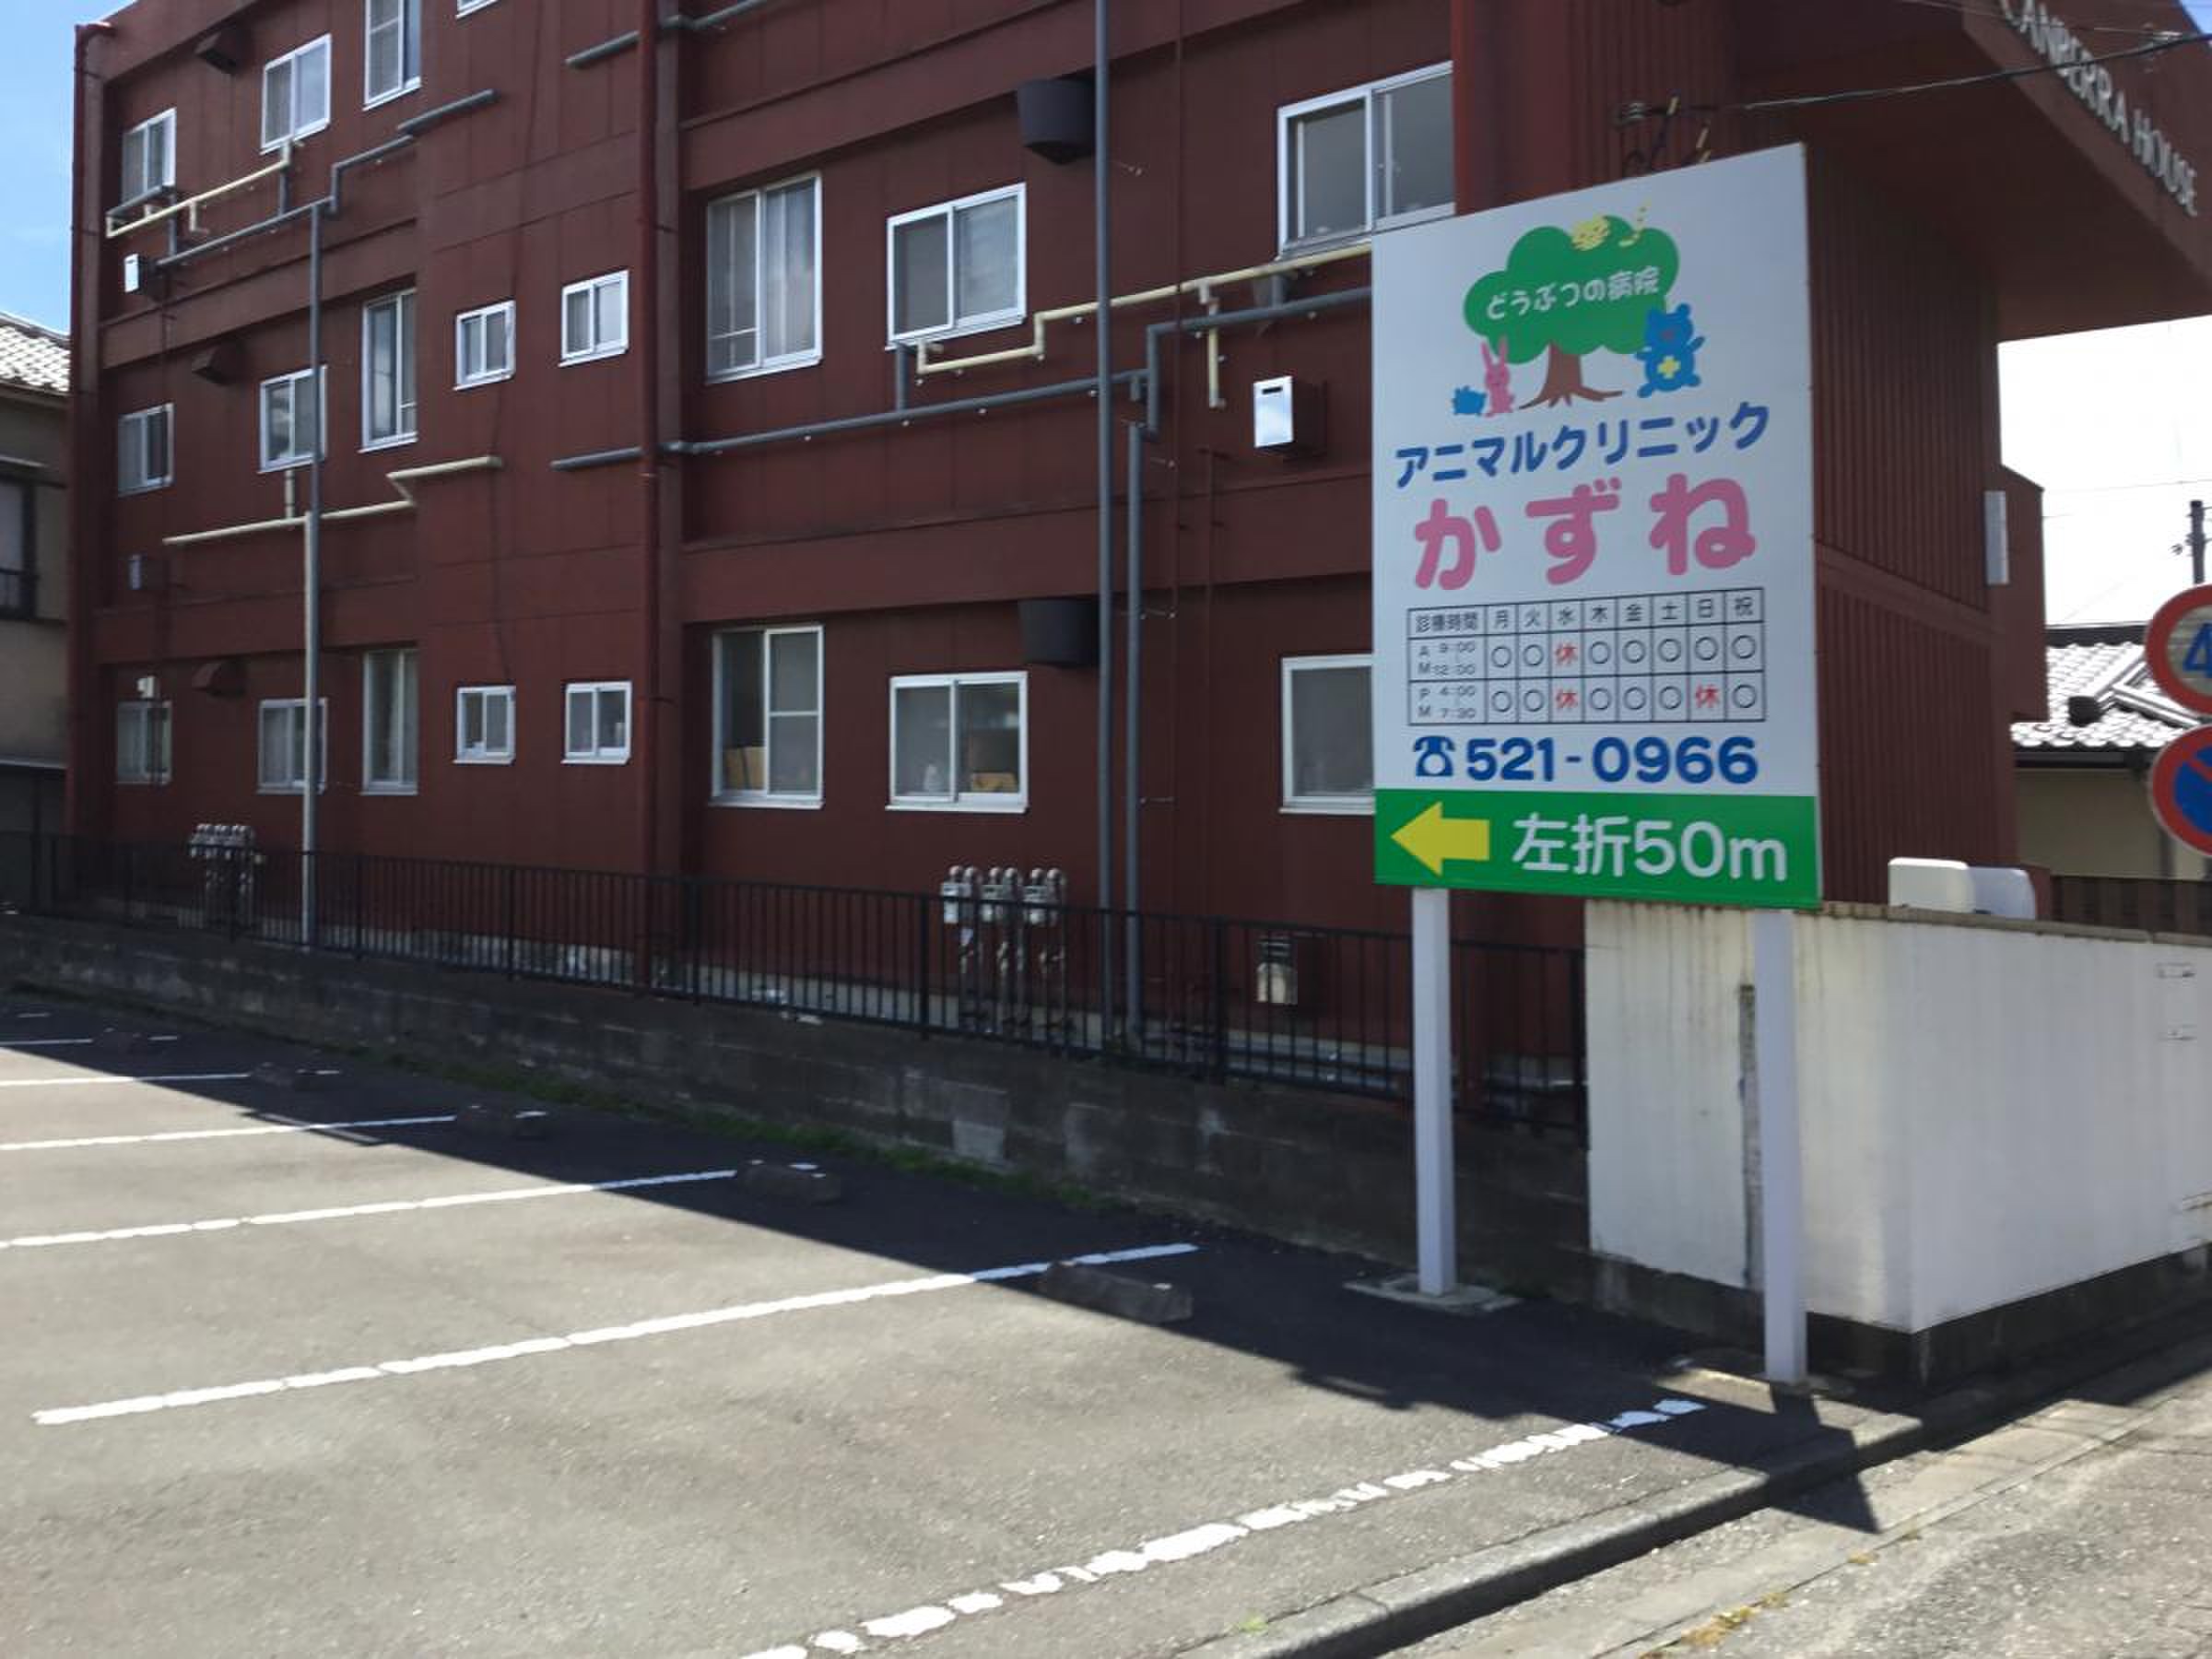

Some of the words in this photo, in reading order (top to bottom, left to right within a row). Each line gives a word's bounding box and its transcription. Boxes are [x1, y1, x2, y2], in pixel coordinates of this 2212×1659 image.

[2133, 107, 2197, 217] HOUSE
[1486, 265, 1660, 321] どうぶつの病院
[1395, 402, 1769, 488] アニマルクリニック
[1414, 472, 1756, 591] かずね
[1493, 609, 1509, 629] 月
[1524, 607, 1541, 628] 火
[1557, 606, 1576, 626] 水
[1592, 603, 1608, 622] 木
[1625, 604, 1643, 622] 金
[1661, 601, 1678, 620] 土
[1698, 598, 1713, 618] 日
[1555, 640, 1579, 664] 休
[1555, 687, 1579, 709] 休
[1694, 682, 1721, 709] 休
[1466, 735, 1759, 784] 521-0966
[1512, 813, 1788, 882] 左折50m
